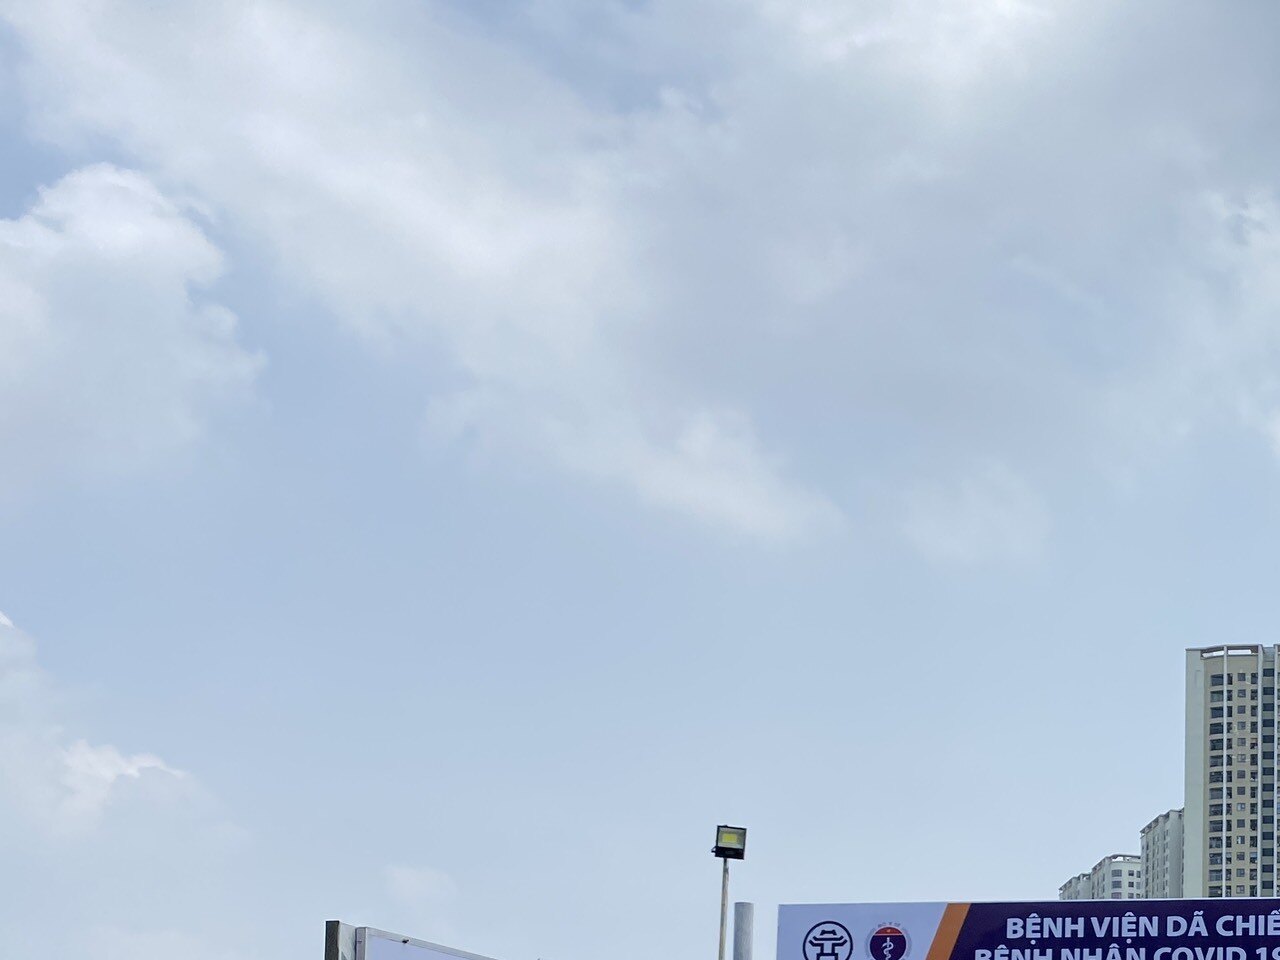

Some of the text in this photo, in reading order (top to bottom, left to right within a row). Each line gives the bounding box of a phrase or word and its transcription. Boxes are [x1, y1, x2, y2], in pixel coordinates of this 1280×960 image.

[1007, 912, 1084, 945] BỆNH
[1091, 912, 1158, 943] VIỆN
[1166, 910, 1208, 937] DÃ
